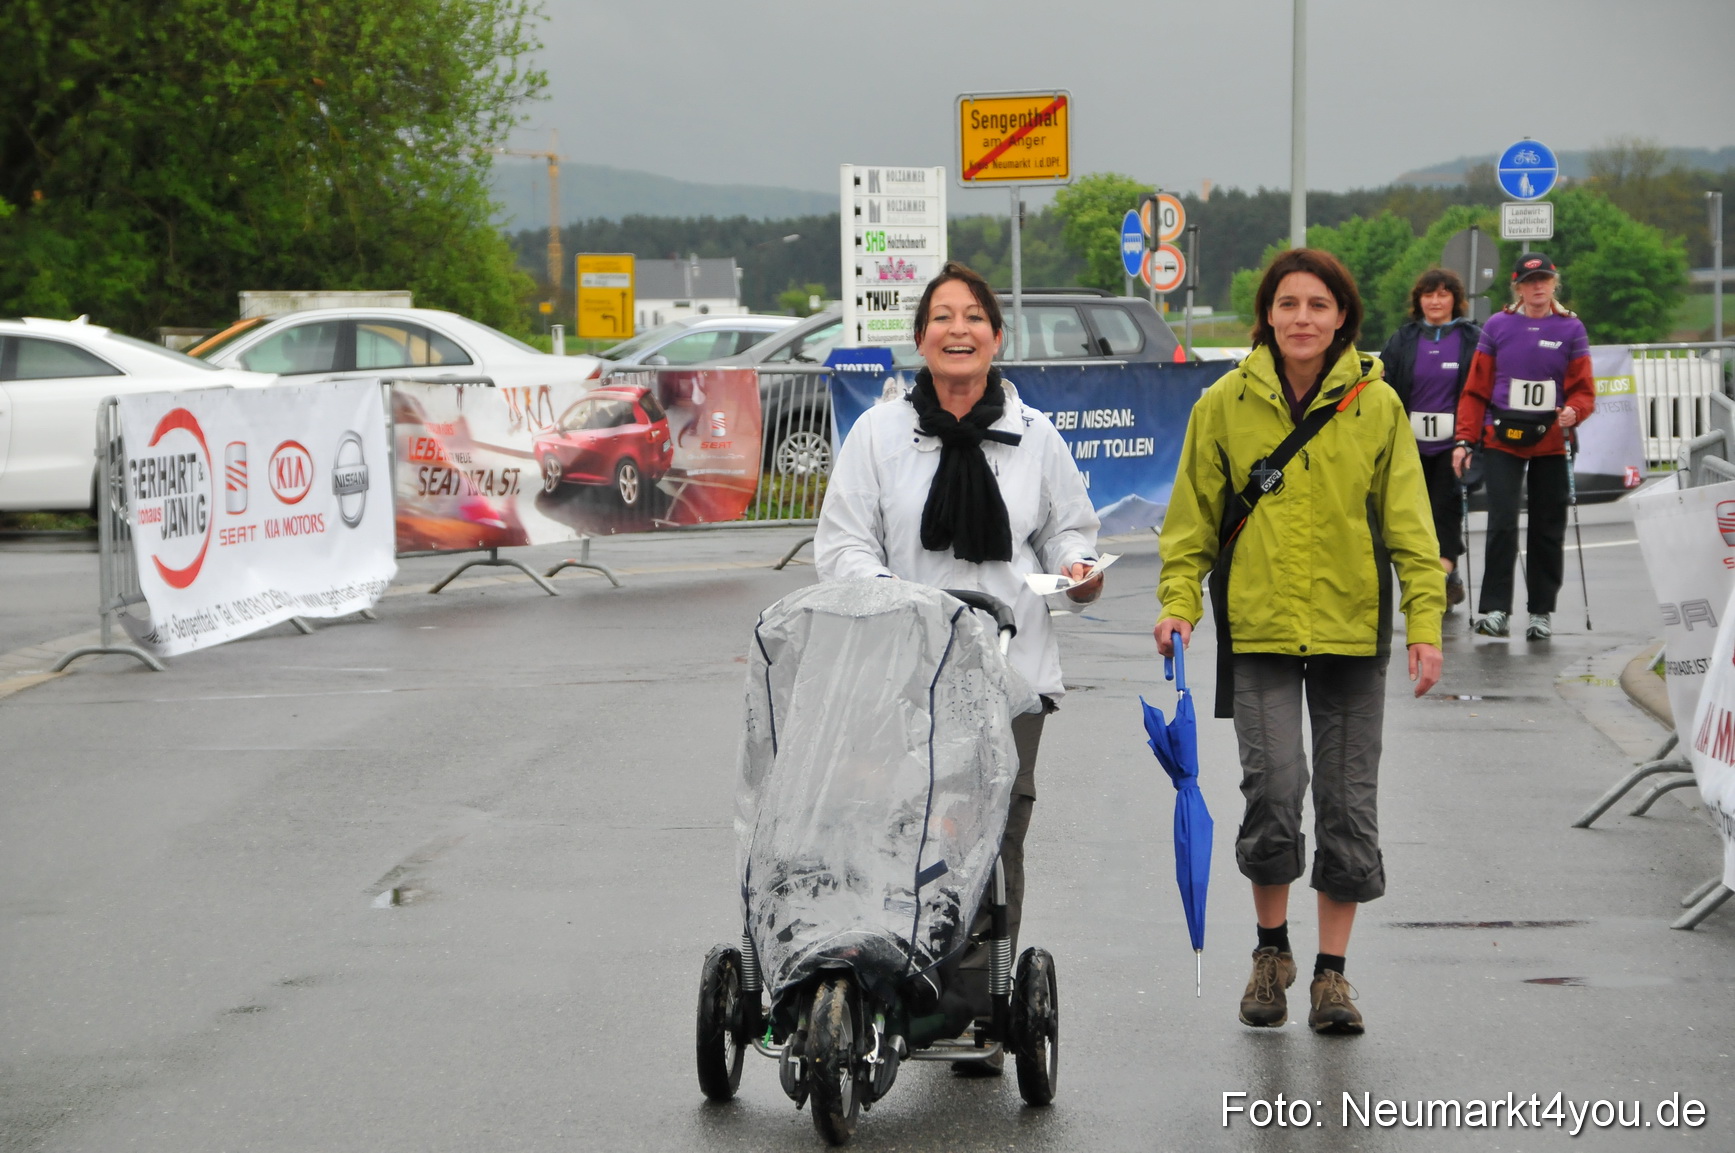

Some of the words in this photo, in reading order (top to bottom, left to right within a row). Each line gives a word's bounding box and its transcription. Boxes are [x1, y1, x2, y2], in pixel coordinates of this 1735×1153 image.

[971, 106, 1058, 134] Sengenthal
[983, 137, 1002, 147] am
[1008, 134, 1047, 149] Anger
[992, 159, 1031, 169] Neumarkt
[886, 170, 925, 182] HOLZAMMER
[887, 199, 926, 211] HOLZAMMER
[1511, 207, 1544, 216] Landwirt-
[865, 230, 886, 252] SHB
[1508, 226, 1533, 235] Verkehr
[1536, 225, 1548, 234] frei
[866, 290, 900, 311] THULE
[1523, 383, 1545, 406] 10
[1055, 411, 1079, 430] BEI
[1081, 408, 1136, 429] NISSAN:
[1422, 415, 1438, 437] 11
[700, 441, 733, 450] SEAT
[1075, 440, 1101, 459] MIT
[1103, 437, 1154, 458] TOLLEN
[276, 456, 306, 490] KIA
[335, 471, 365, 489] NISSAN
[497, 467, 521, 496] ST.
[160, 494, 206, 541] JÄNIG
[264, 518, 280, 539] KIA
[282, 513, 325, 537] MOTORS
[219, 524, 257, 546] SEAT
